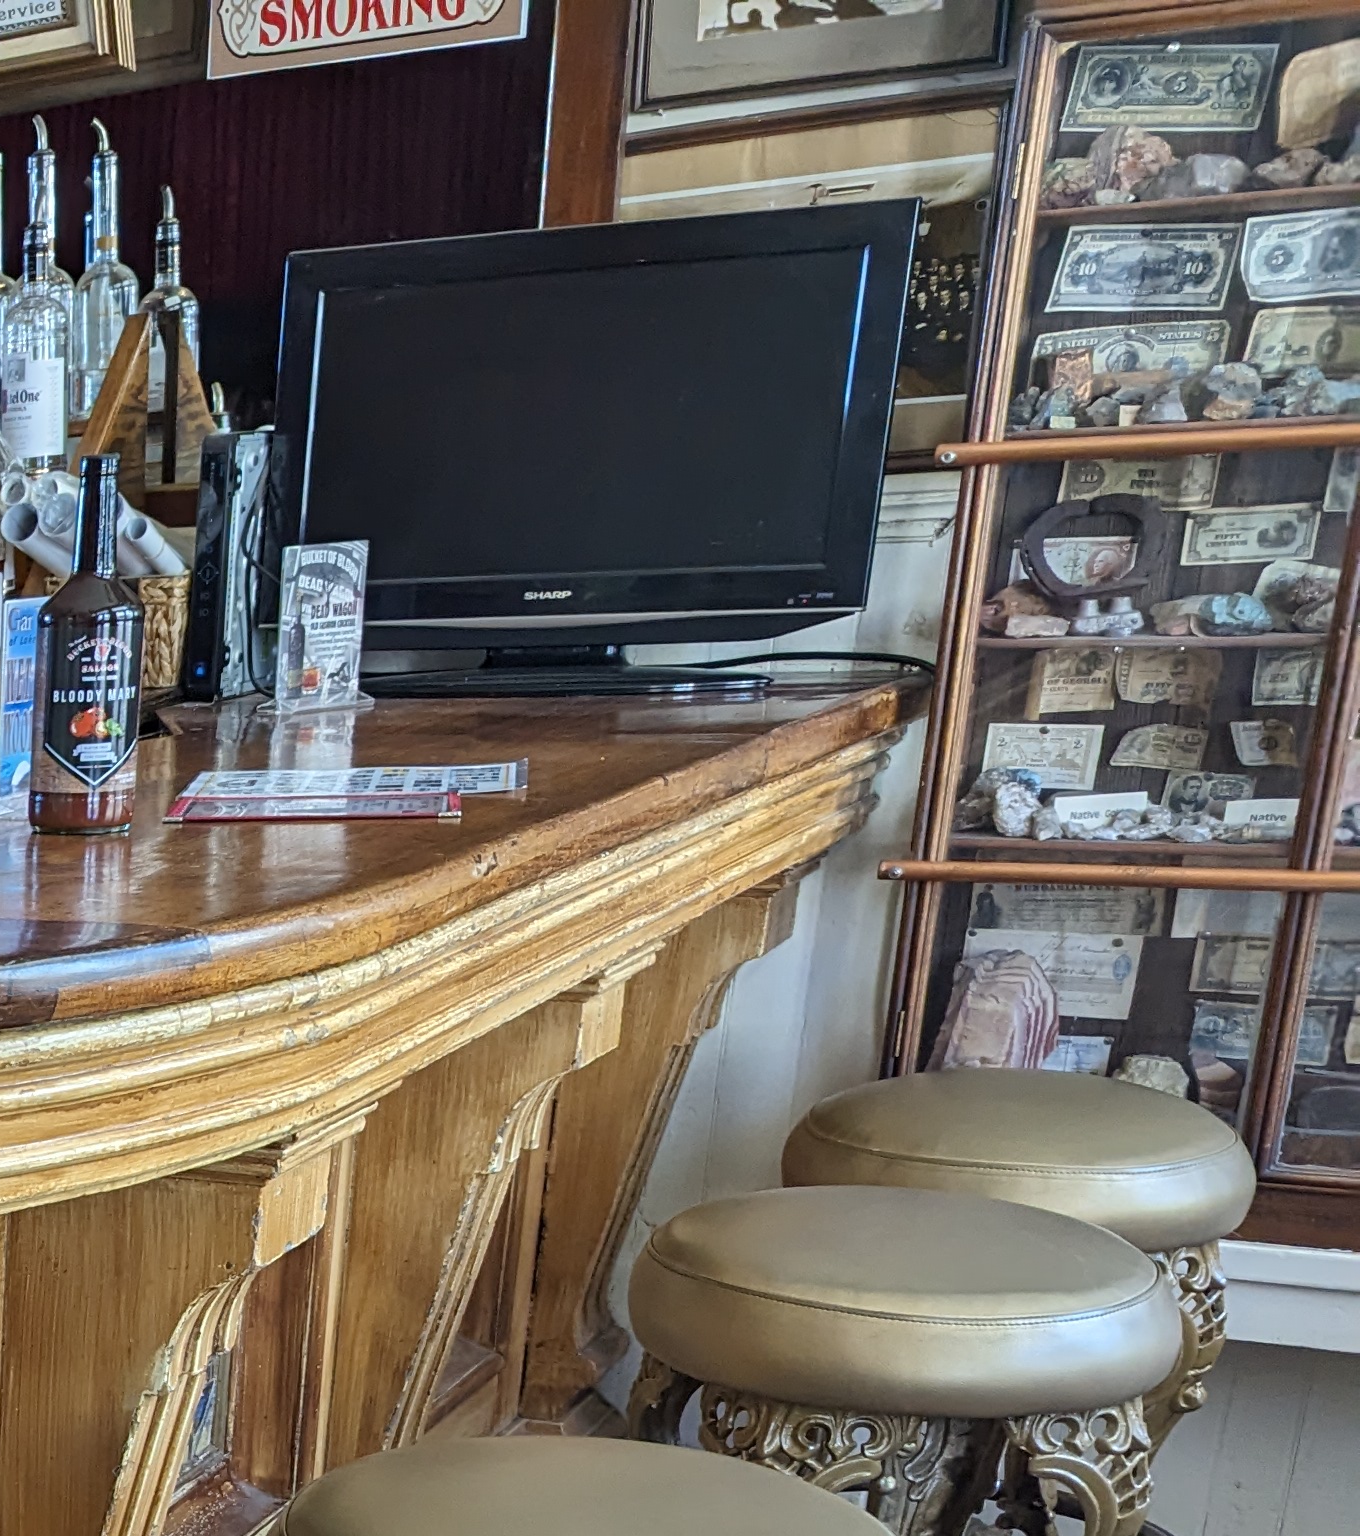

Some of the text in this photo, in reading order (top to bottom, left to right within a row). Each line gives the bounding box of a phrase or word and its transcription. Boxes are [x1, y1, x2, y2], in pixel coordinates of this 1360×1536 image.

[259, 0, 466, 47] SMOKING
[300, 550, 359, 583] BUCKET OF BLOOD
[297, 574, 324, 593] DEAD
[524, 590, 572, 600] SHARP
[311, 599, 357, 620] DEAD WAGON
[52, 685, 137, 704] BLOODY MARY
[1069, 808, 1102, 821] Native
[1248, 811, 1288, 823] Native
